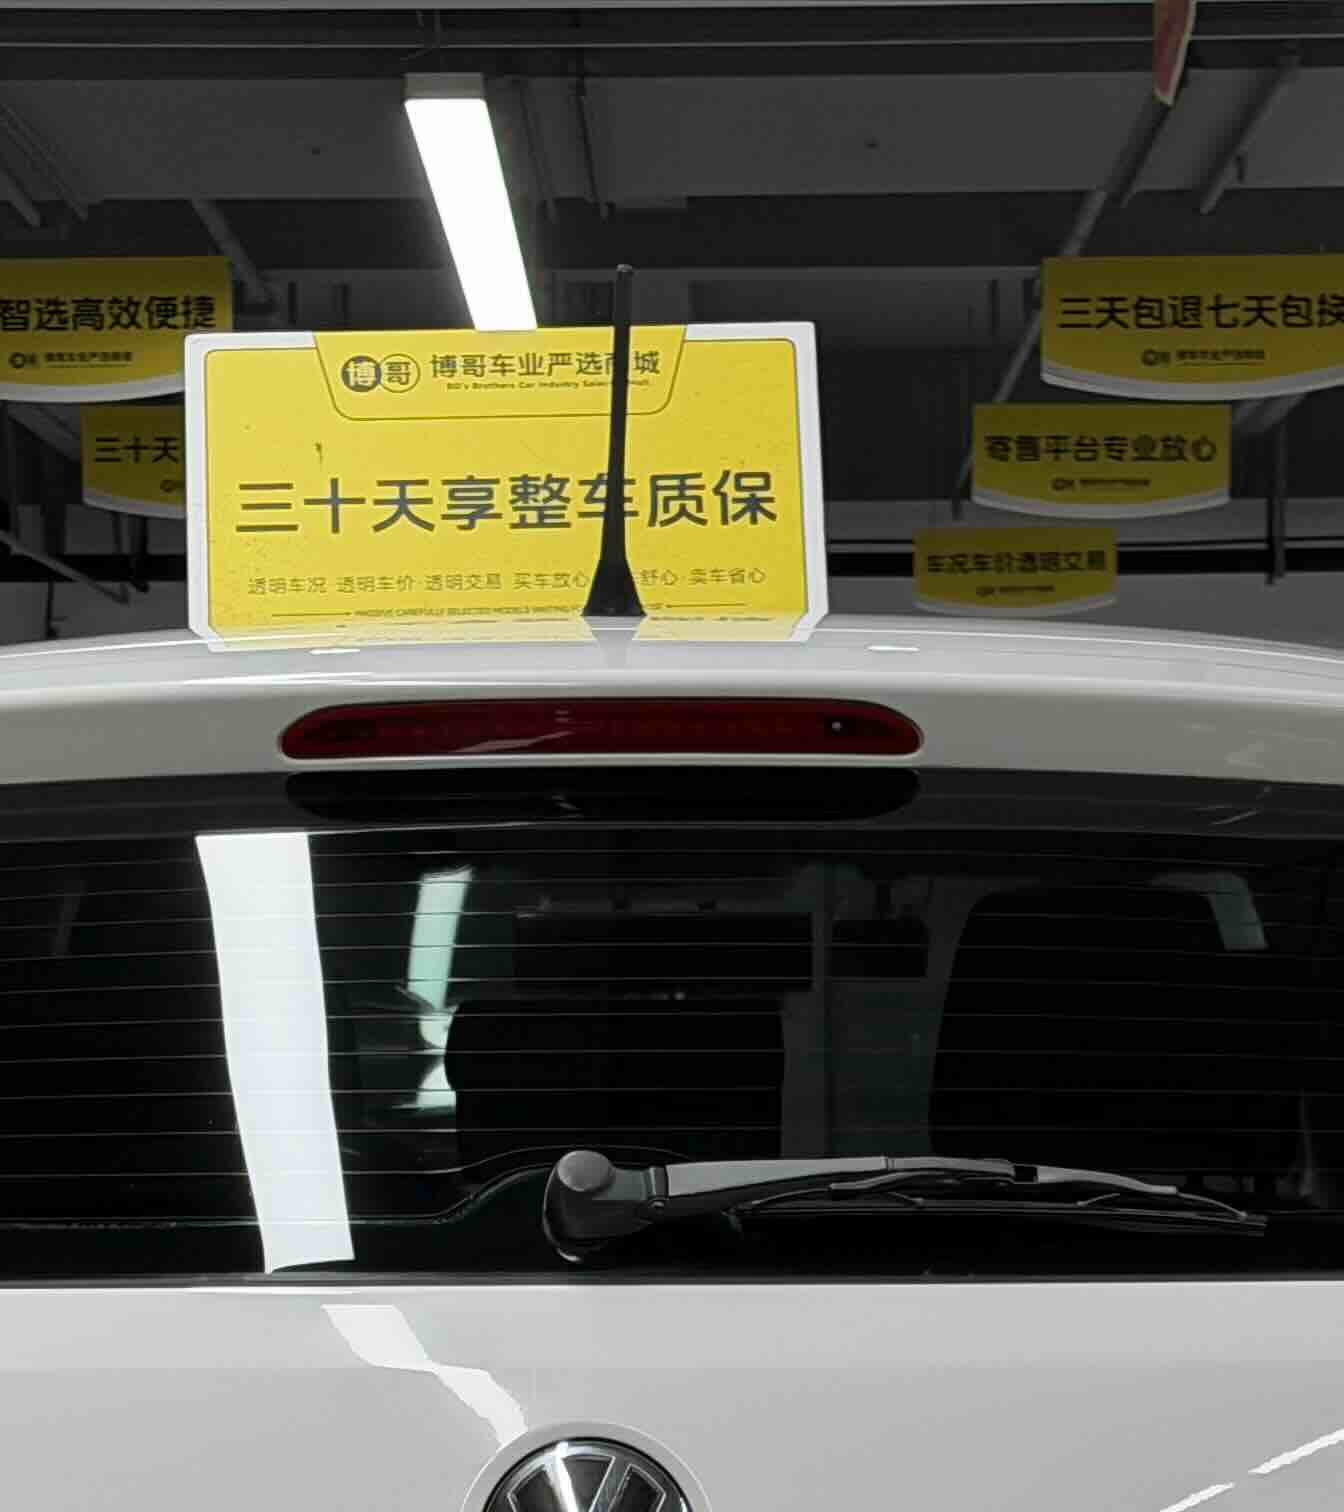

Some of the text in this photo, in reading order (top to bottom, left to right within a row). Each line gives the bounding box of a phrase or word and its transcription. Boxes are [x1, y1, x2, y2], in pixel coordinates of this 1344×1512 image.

[93, 434, 179, 464] 三十天
[236, 469, 779, 535] 三十天享整车质保
